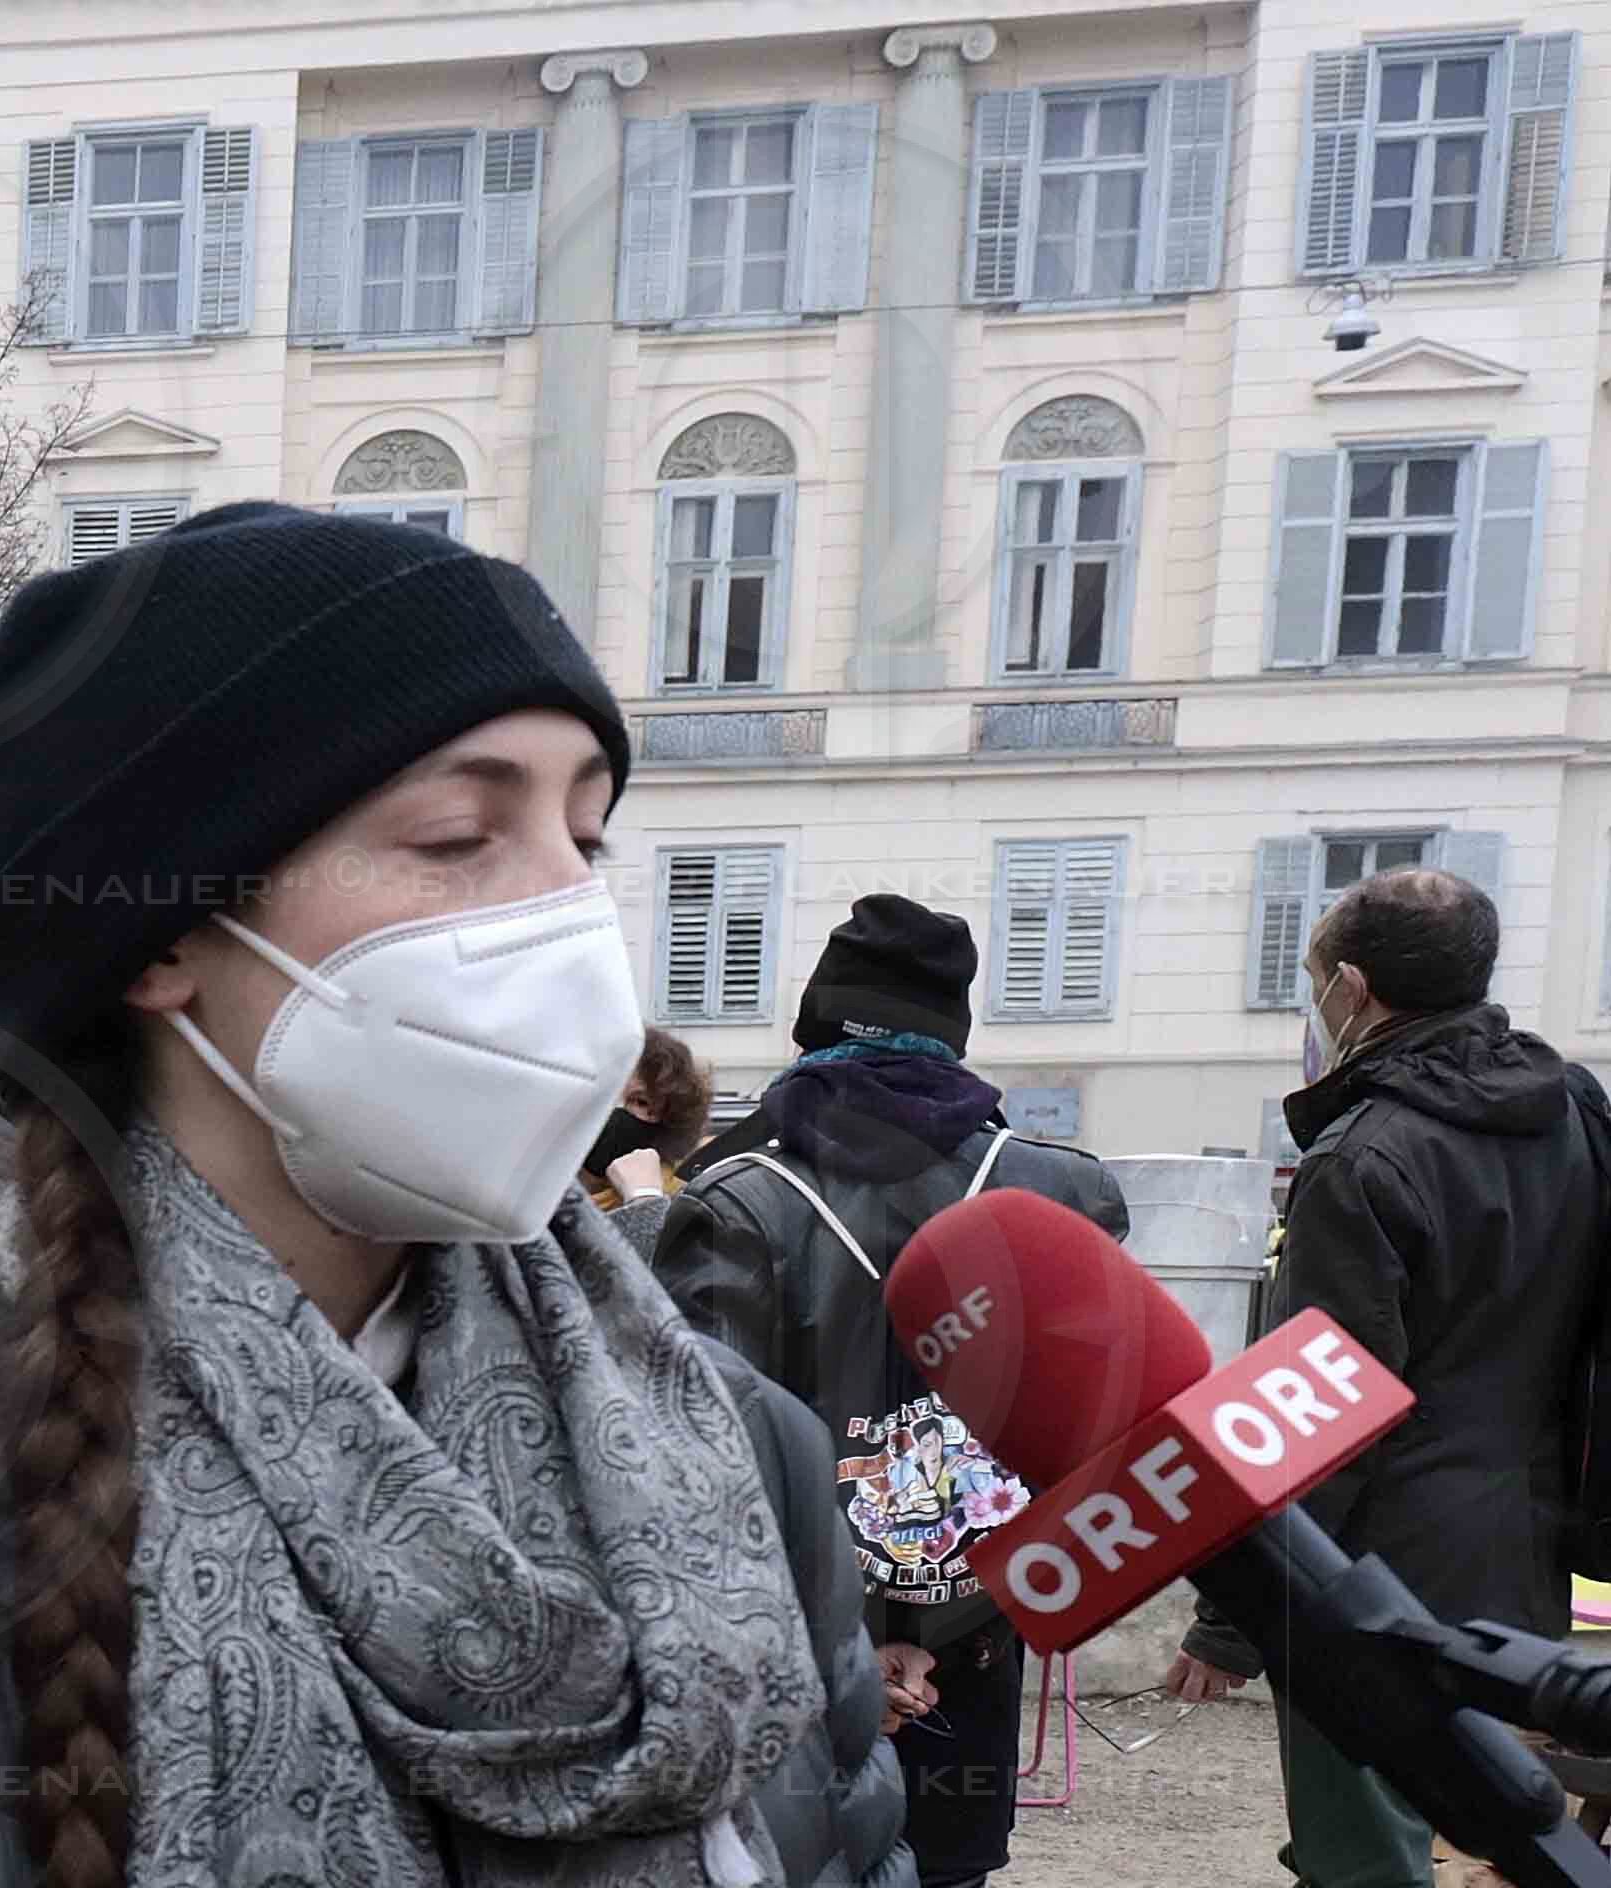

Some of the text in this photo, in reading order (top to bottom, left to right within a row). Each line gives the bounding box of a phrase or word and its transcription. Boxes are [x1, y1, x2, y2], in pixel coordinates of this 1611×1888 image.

[914, 1285, 997, 1368] ORF
[1211, 1328, 1365, 1468] ORF
[1005, 1436, 1201, 1616] ORF
